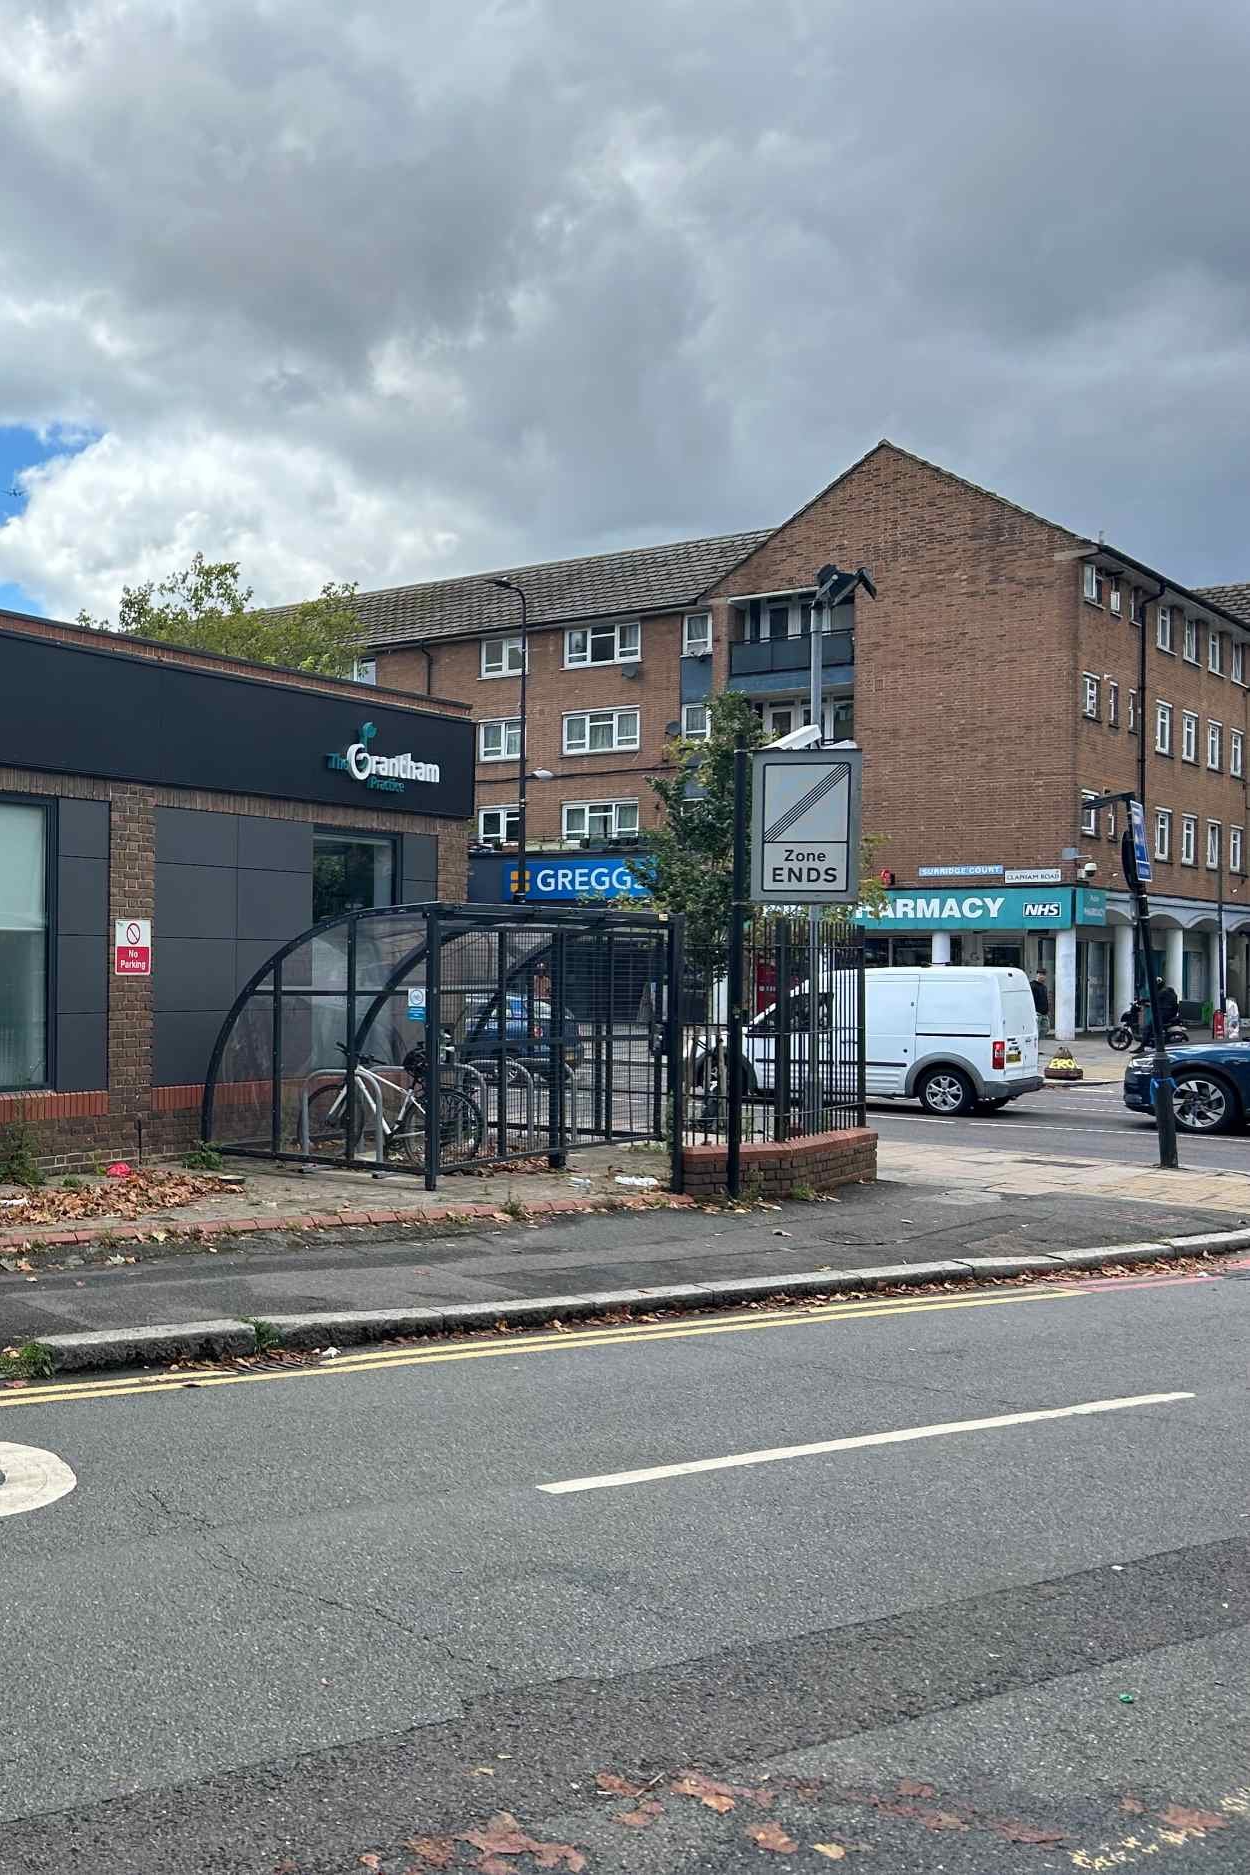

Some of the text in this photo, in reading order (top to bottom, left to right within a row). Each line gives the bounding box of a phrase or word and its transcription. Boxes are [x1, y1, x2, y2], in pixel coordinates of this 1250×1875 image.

[346, 743, 440, 783] Grantham
[783, 849, 827, 862] Zone
[772, 867, 838, 883] ENDS
[969, 865, 999, 875] COURT
[536, 868, 646, 892] GREGG
[836, 897, 1006, 919] HARMACY
[1024, 903, 1060, 917] NHS
[128, 949, 139, 958] No
[120, 959, 146, 970] Parking
